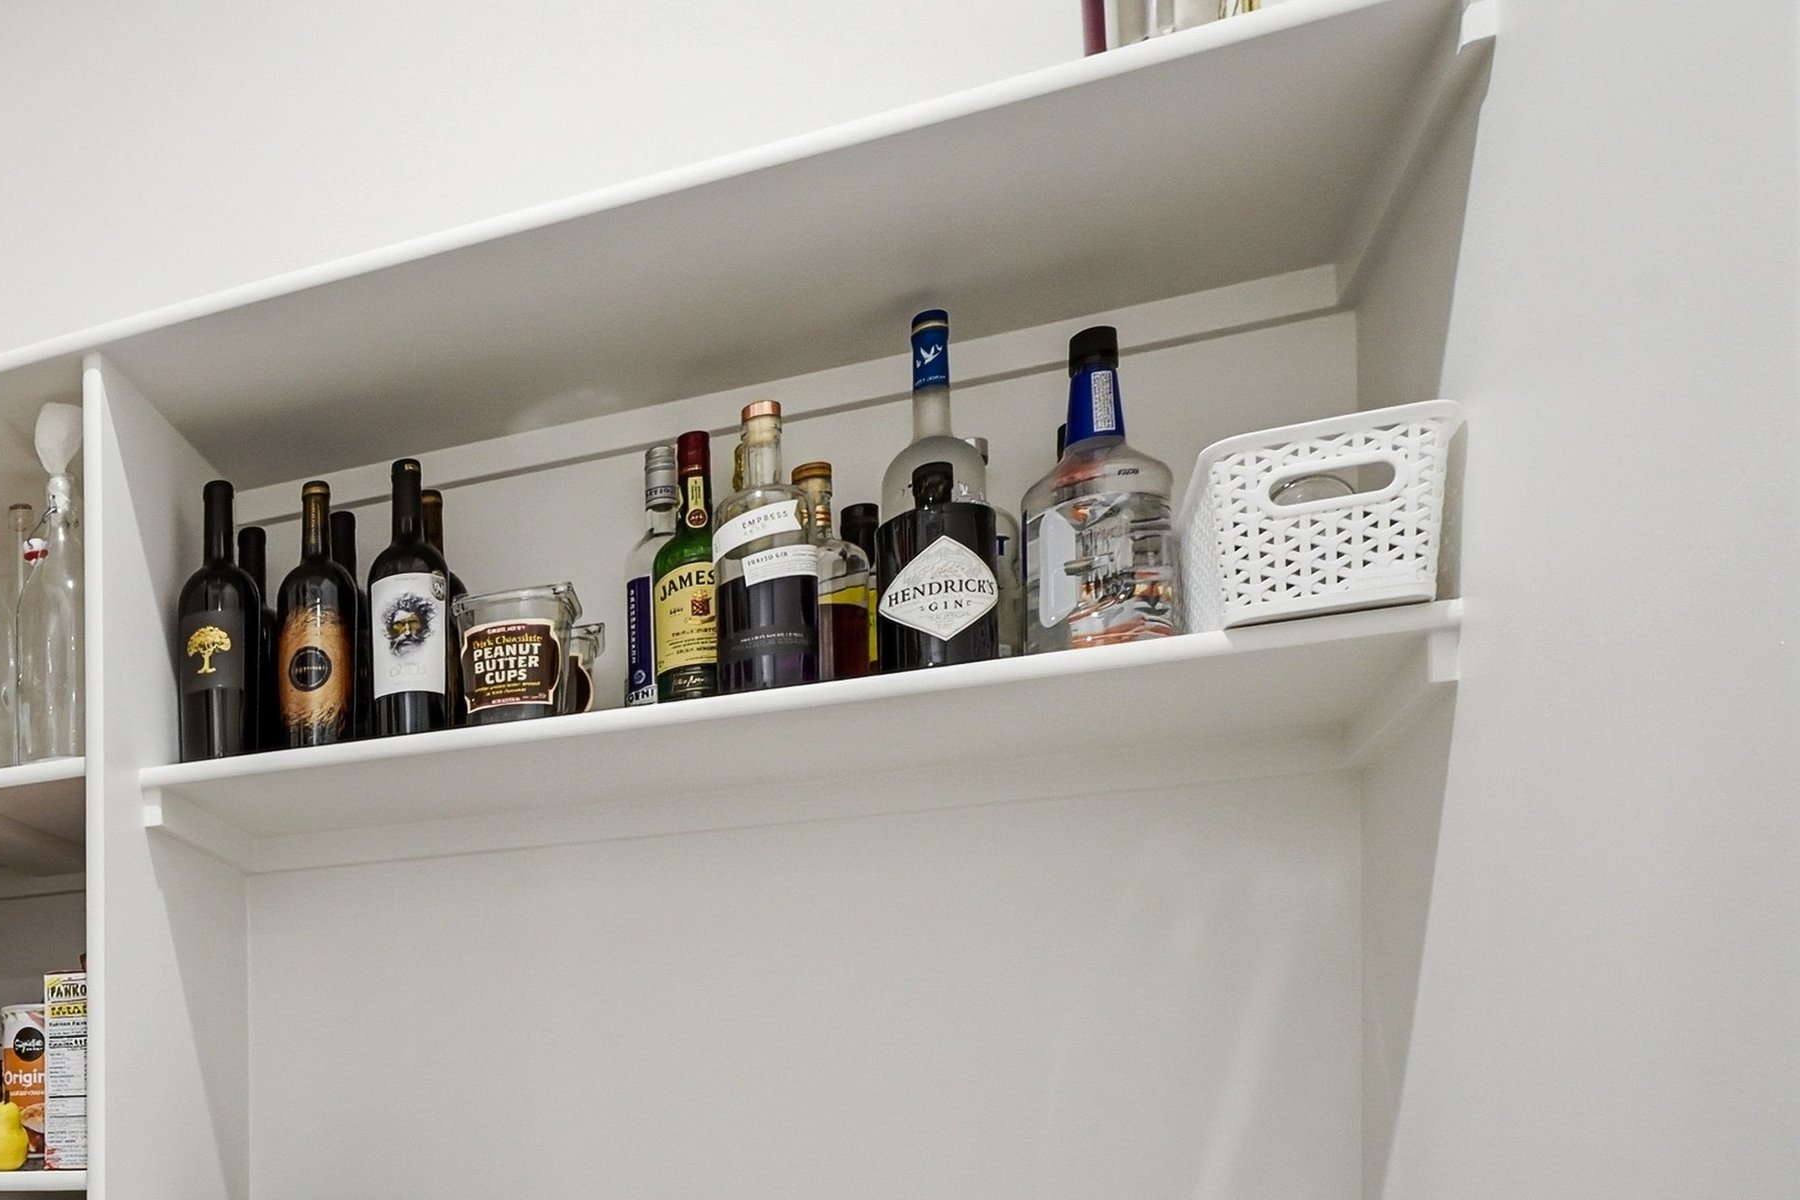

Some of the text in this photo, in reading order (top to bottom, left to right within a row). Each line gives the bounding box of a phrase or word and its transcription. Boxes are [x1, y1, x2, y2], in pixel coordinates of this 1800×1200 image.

[659, 569, 716, 602] JAMES
[887, 577, 998, 608] HENDRICK'S
[928, 599, 963, 613] GIN
[473, 643, 542, 662] PEANUT
[474, 655, 540, 675] BUTTER
[485, 668, 528, 685] CUPS
